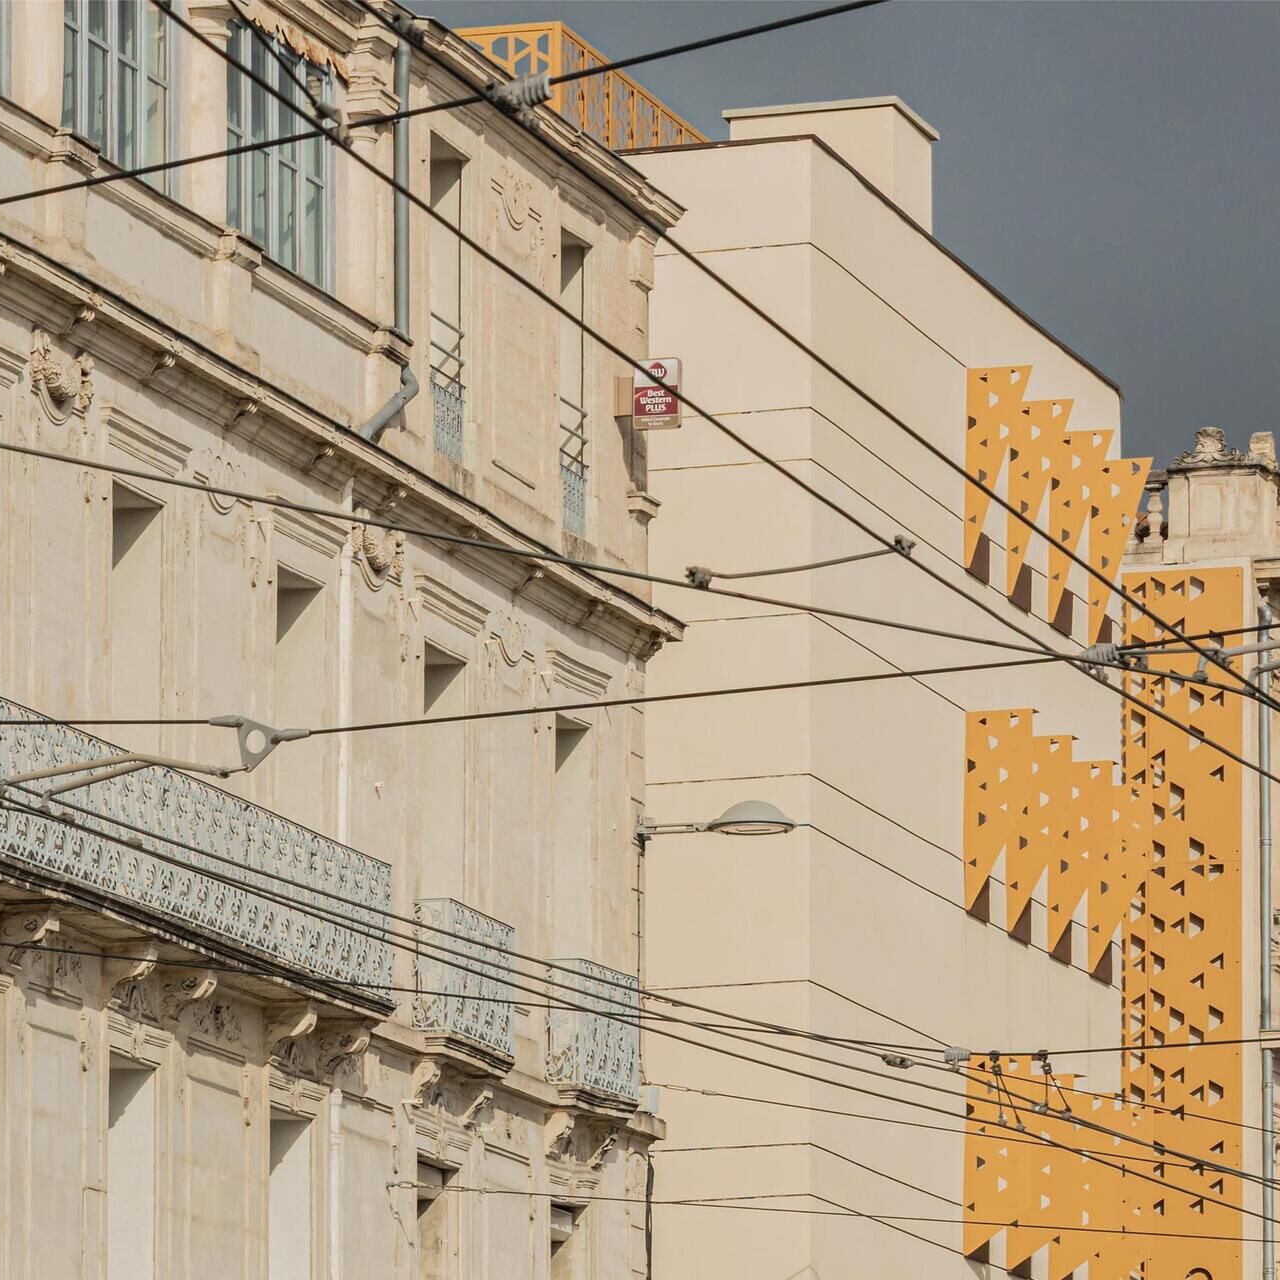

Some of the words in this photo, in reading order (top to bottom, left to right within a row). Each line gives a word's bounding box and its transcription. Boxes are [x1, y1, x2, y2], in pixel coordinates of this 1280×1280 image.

[647, 389, 665, 397] Best
[640, 396, 671, 404] Western
[645, 404, 666, 412] PLUS
